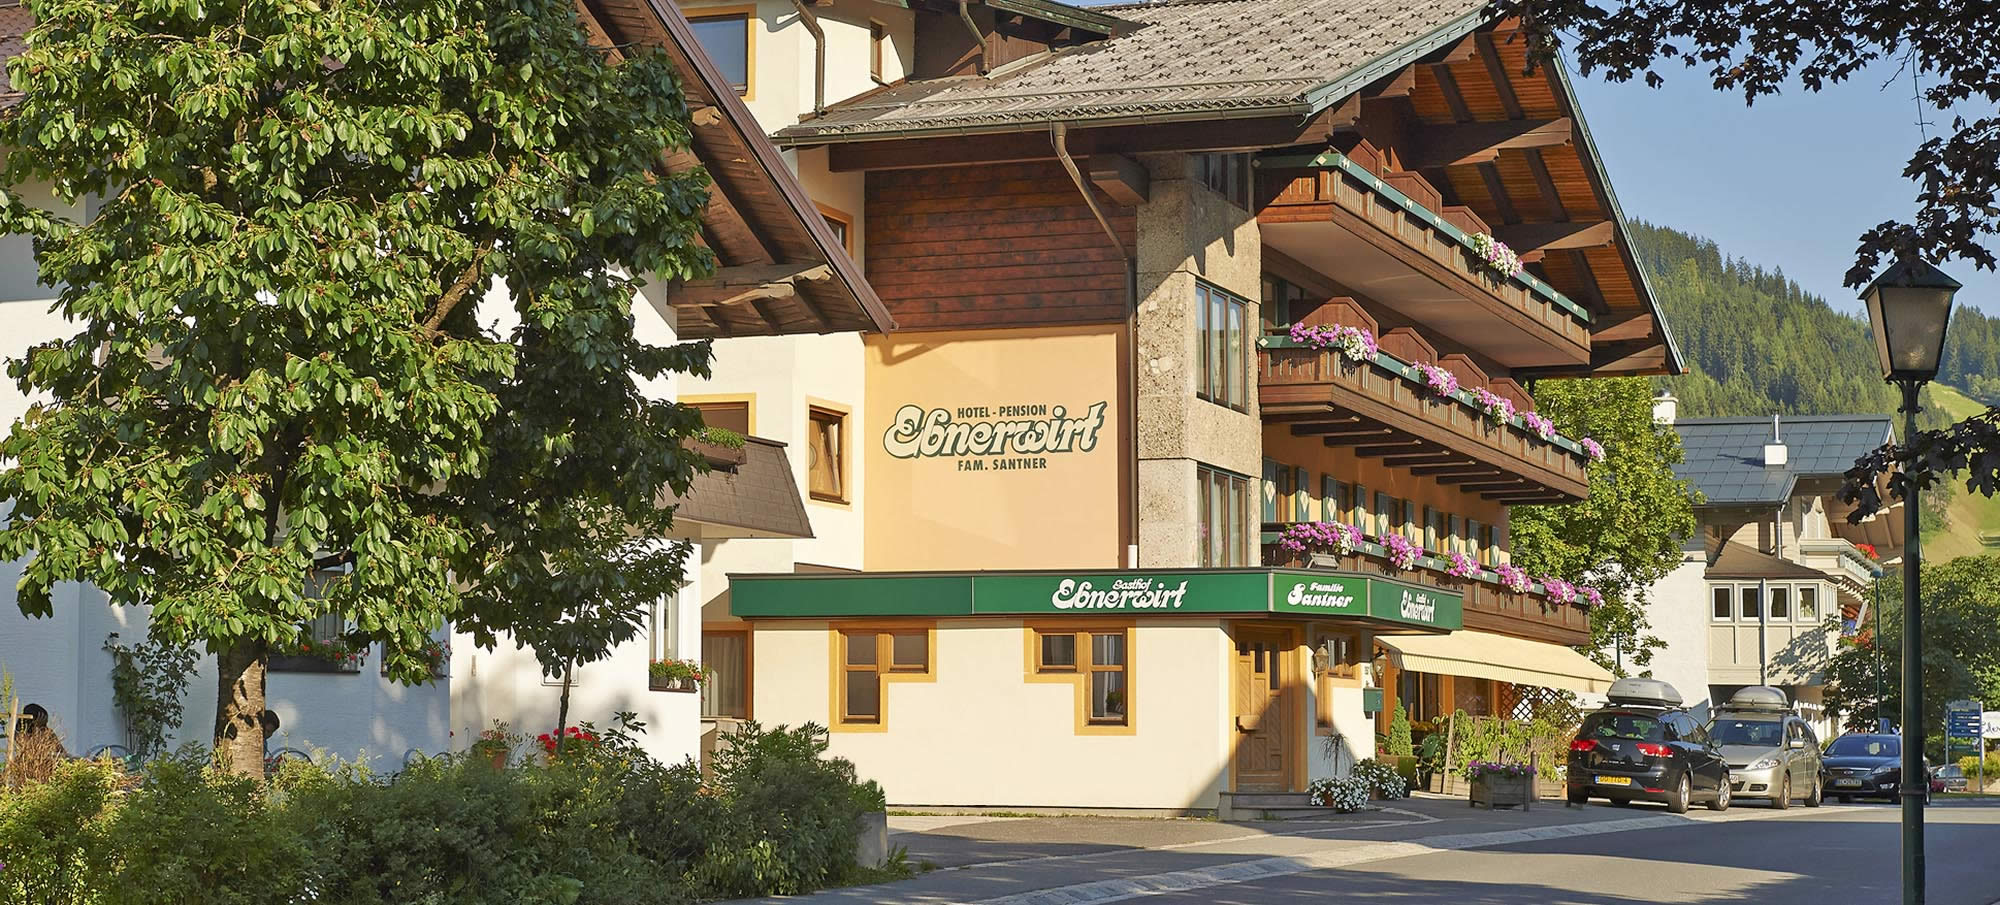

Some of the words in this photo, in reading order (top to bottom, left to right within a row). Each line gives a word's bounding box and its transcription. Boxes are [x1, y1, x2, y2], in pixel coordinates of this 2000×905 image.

[957, 407, 991, 419] HOTEL
[999, 404, 1047, 417] PENSION
[883, 401, 1107, 458] Ebnerwirt
[957, 460, 989, 471] FAM.
[992, 458, 1047, 470] SANTNER
[1112, 578, 1153, 591] Gasthof
[1310, 582, 1344, 593] Familie
[1052, 578, 1188, 609] Ebnerwirt
[1287, 583, 1353, 608] Santner
